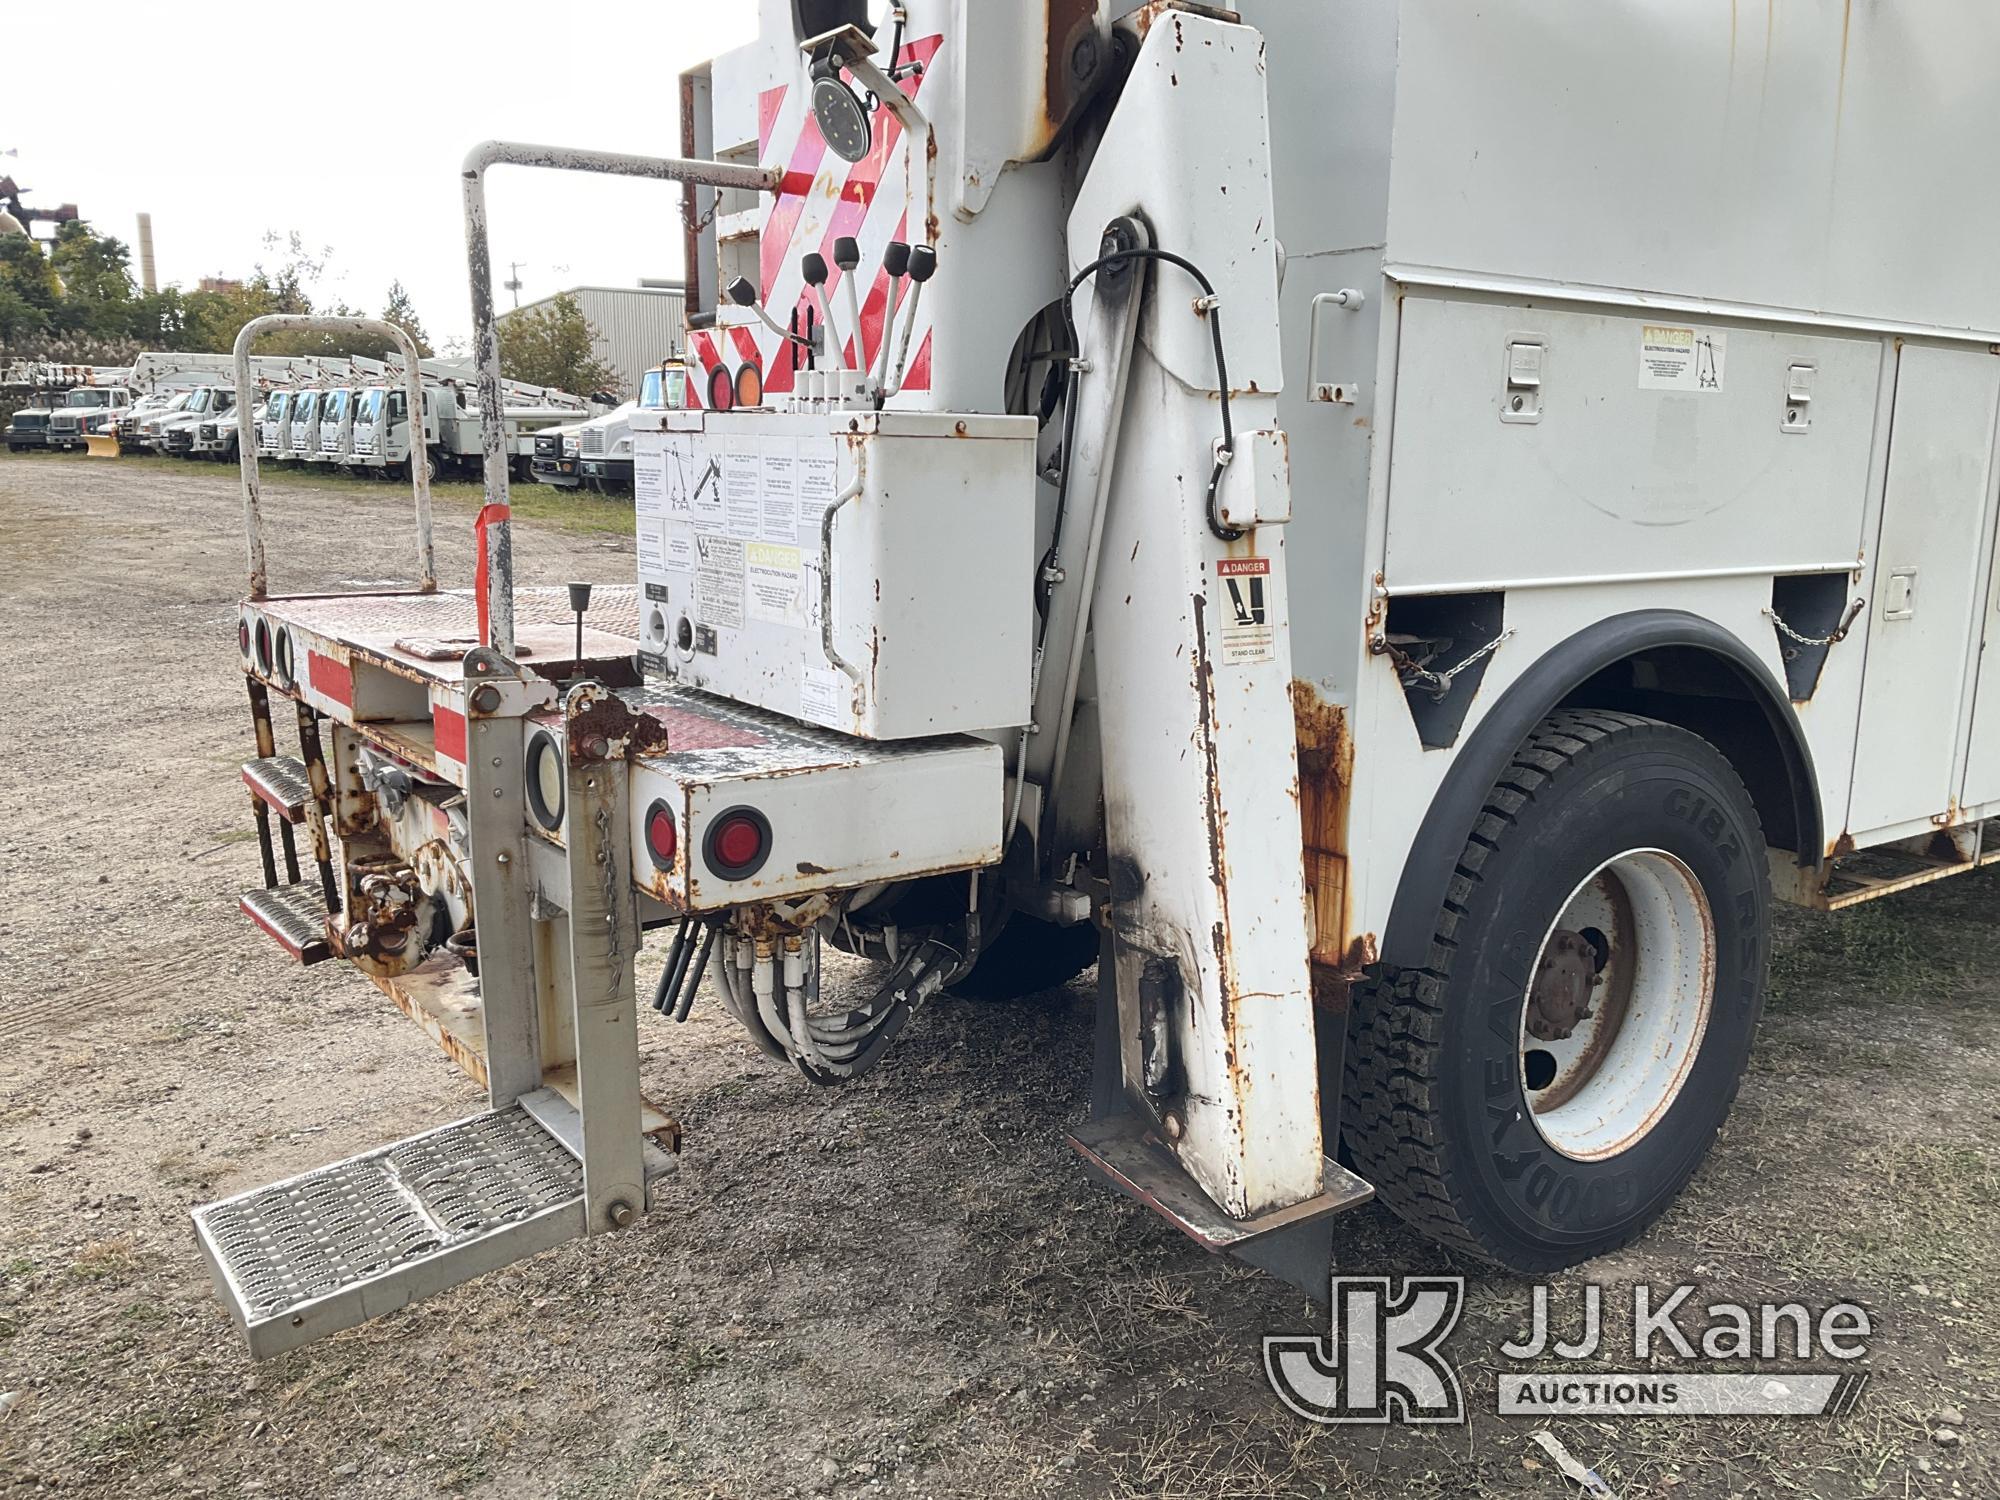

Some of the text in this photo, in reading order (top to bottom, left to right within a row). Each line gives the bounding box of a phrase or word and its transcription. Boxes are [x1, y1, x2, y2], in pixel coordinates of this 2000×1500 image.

[758, 548, 797, 568] DANGER
[1231, 562, 1265, 573] DANGER
[1663, 787, 1742, 871] G182
